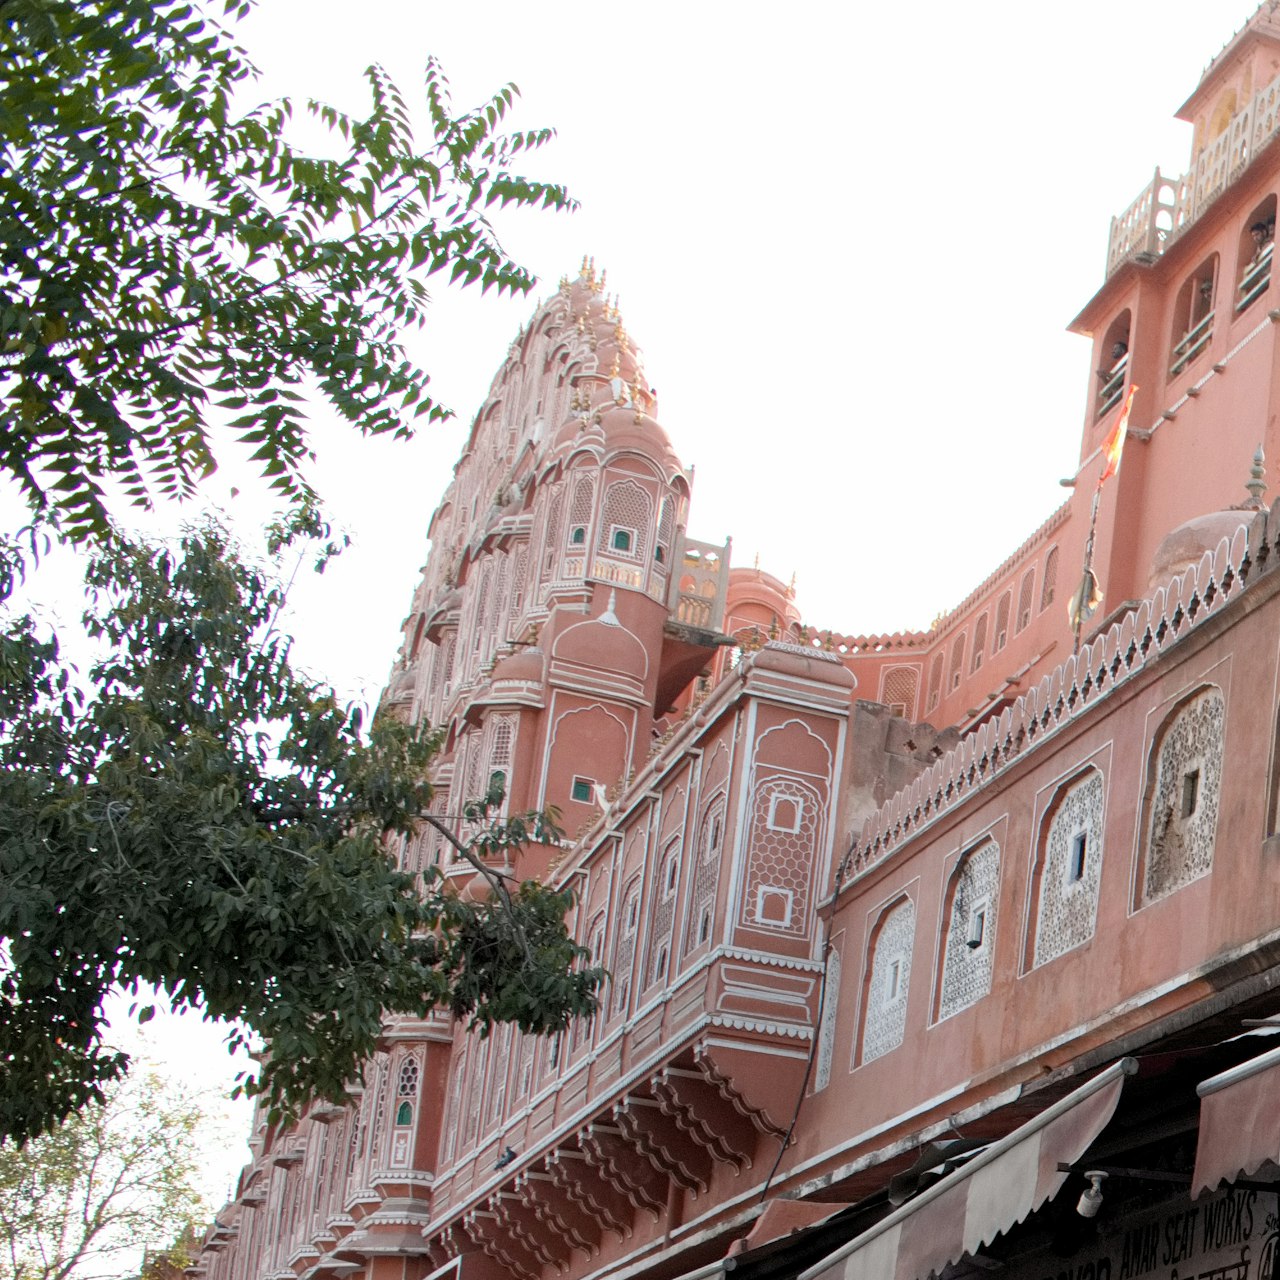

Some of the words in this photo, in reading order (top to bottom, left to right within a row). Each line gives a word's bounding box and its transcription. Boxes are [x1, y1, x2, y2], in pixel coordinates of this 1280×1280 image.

[1119, 1222, 1160, 1280] AMAR
[1163, 1207, 1200, 1266] SEAT
[1203, 1189, 1257, 1253] WORKS
